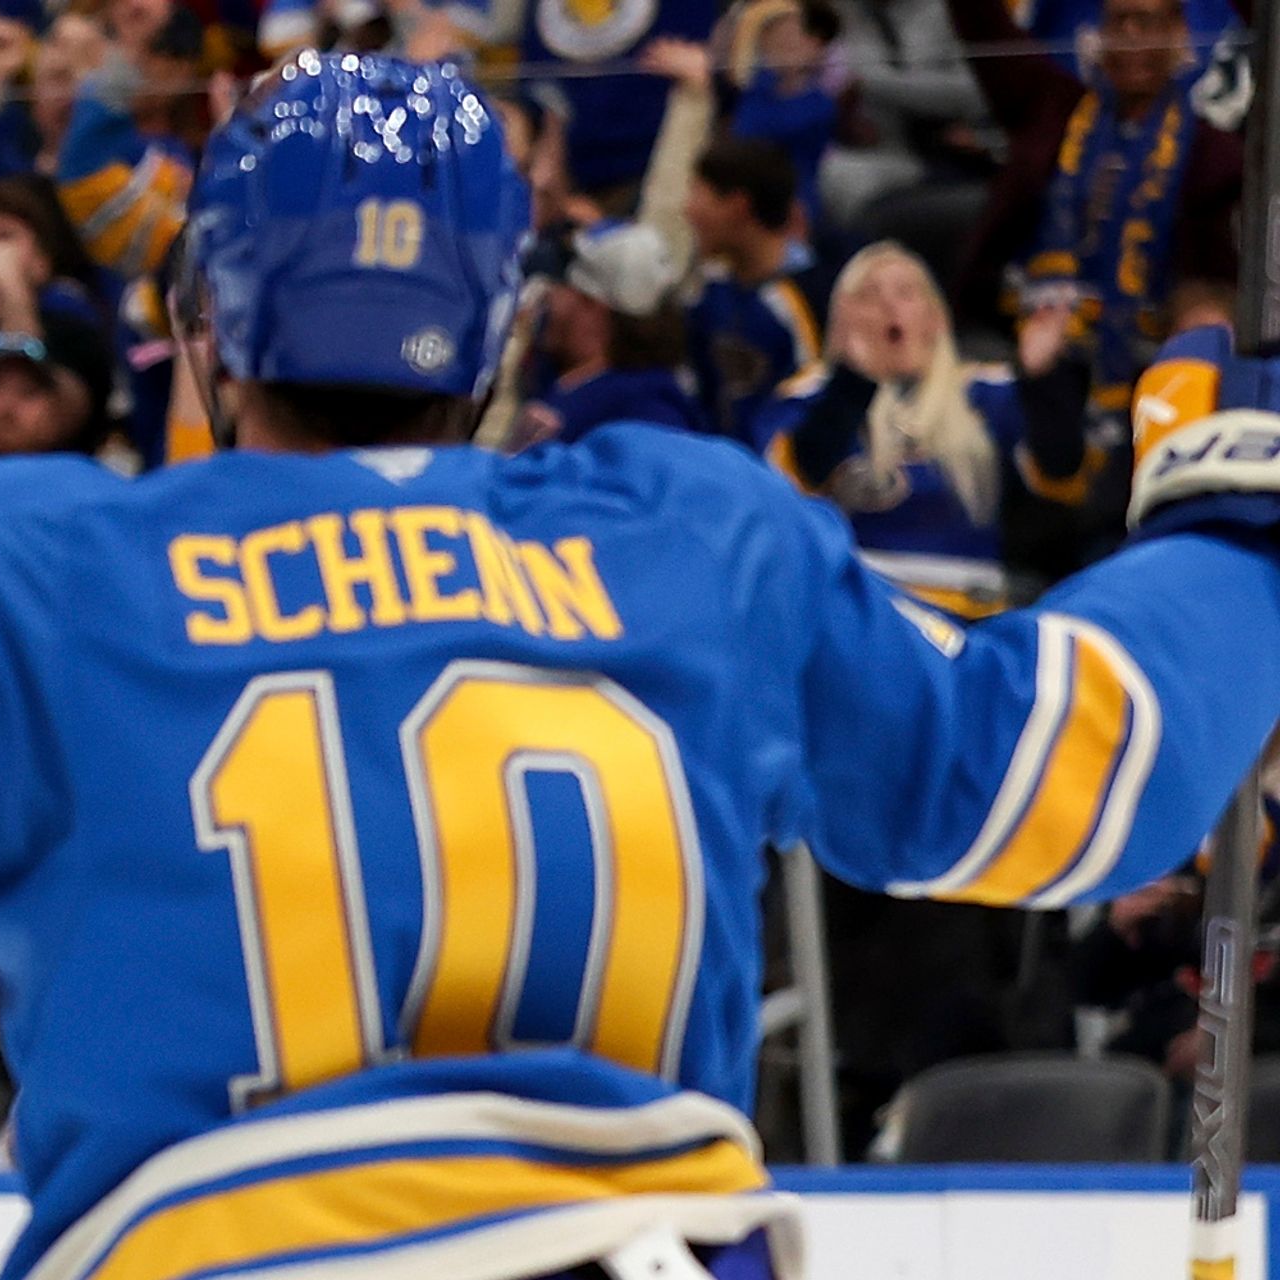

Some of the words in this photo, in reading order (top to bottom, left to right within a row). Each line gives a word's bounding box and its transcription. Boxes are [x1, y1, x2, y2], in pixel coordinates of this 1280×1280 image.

[354, 197, 425, 270] 10
[168, 505, 625, 646] SCHENN
[188, 658, 707, 1116] 10
